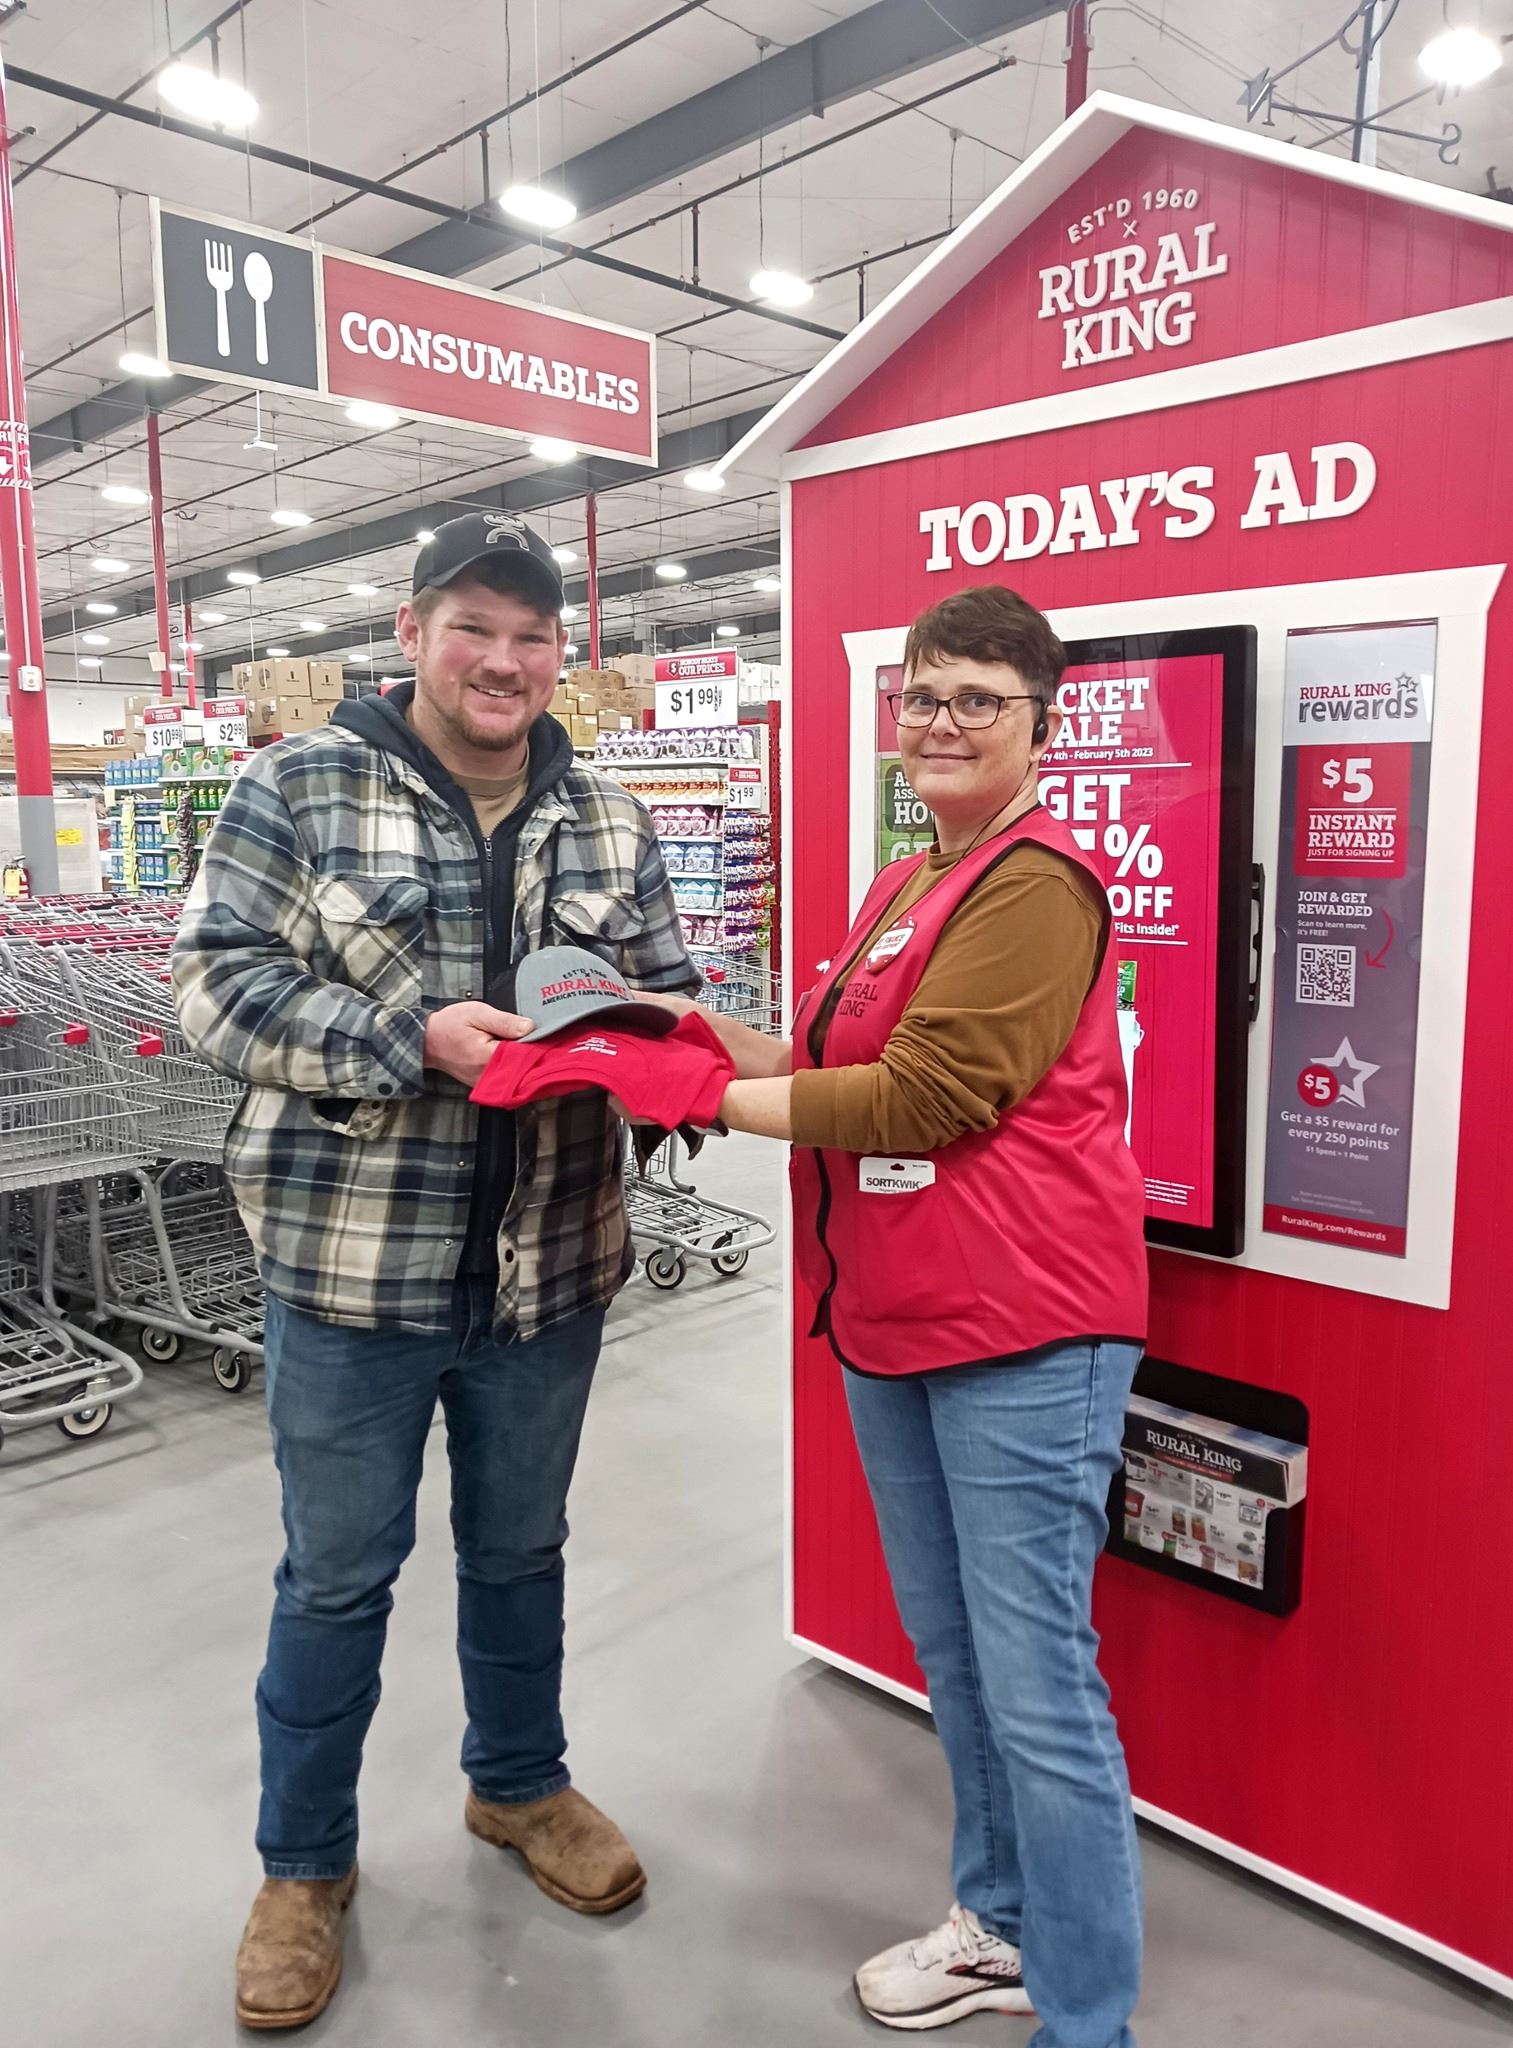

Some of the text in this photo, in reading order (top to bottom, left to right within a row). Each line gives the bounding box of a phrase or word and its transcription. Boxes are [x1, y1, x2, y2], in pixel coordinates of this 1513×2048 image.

[1066, 188, 1199, 245] EST'D 1960
[1038, 222, 1229, 320] RURAL
[1062, 291, 1197, 370] KING
[340, 311, 640, 415] CONSUMABLES
[919, 441, 1377, 572] TODAY'S AD
[679, 663, 725, 676] OUR PRICES
[1300, 683, 1392, 700] RURAL KING
[1299, 689, 1418, 723] rewards
[1053, 751, 1068, 760] 4th
[1074, 749, 1113, 761] February
[1115, 748, 1130, 758] 5th
[1132, 747, 1153, 758] 2023
[1322, 758, 1374, 804] $5
[1037, 773, 1131, 822] GET
[1309, 814, 1396, 831] INSTANT
[1308, 832, 1395, 848] REWARD
[1308, 849, 1394, 858] JUST FOR SIGNING UP
[1105, 884, 1173, 918] OFF
[1297, 904, 1373, 917] REWARDED
[1298, 891, 1367, 904] JOIN & GET
[1115, 922, 1134, 934] Fits
[1316, 920, 1324, 928] to
[1325, 921, 1344, 929] learn
[541, 977, 598, 998] RURAL
[1304, 1073, 1331, 1100] $5
[1281, 1110, 1399, 1136] Get a $5 reward for
[1288, 1129, 1390, 1151] every 250 points
[1281, 1214, 1387, 1242] RuralKing.com/Rewards
[1146, 1429, 1200, 1459] RURAL
[1203, 1448, 1243, 1472] KING
